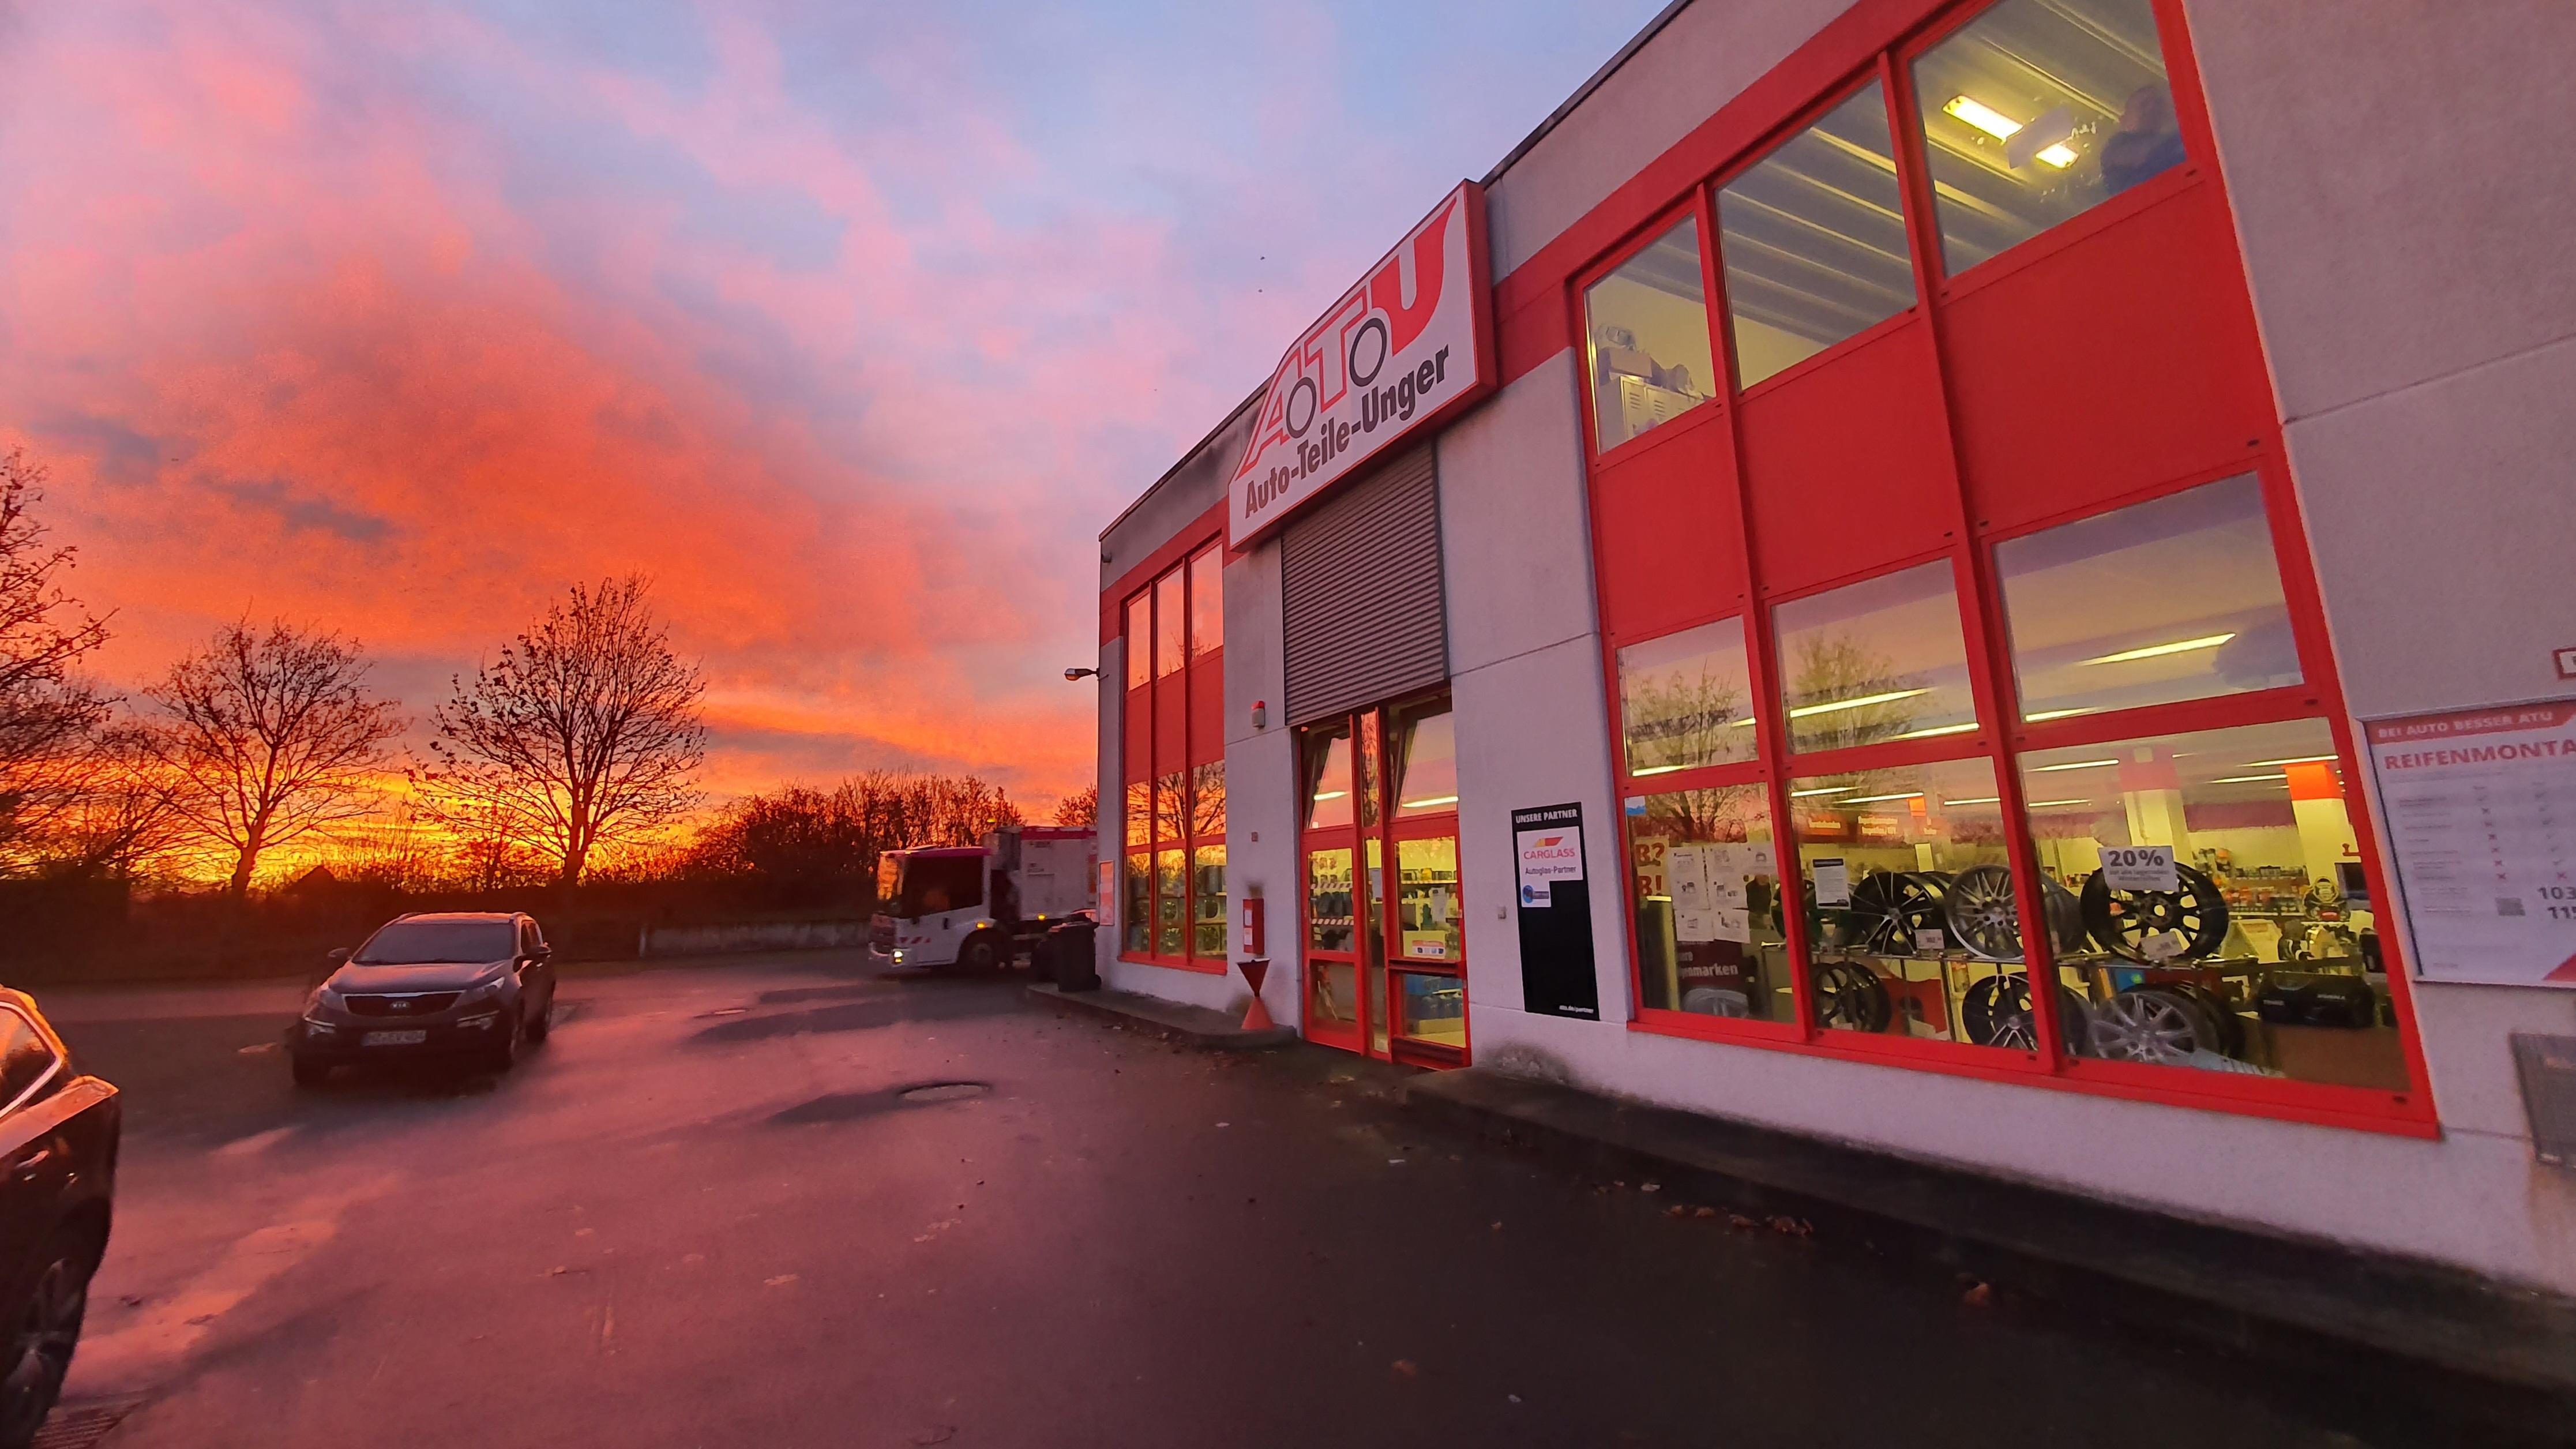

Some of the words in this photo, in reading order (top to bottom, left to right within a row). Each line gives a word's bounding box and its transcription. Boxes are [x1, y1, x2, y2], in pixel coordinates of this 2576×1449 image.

[1245, 344, 1450, 519] Auto-Teile-Unger
[2378, 728, 2402, 738] BEI
[2406, 722, 2449, 735] AUTO
[2454, 716, 2513, 731] BESSER
[2518, 711, 2552, 724] ATU
[2385, 739, 2576, 769] REIFENMONTA
[1515, 813, 1542, 824] UNSERE
[1544, 809, 1578, 821] PARTNER
[1523, 848, 1576, 859] CARGLASS
[2108, 849, 2165, 867] 20%
[1525, 866, 1576, 876] Autoglas-Partner
